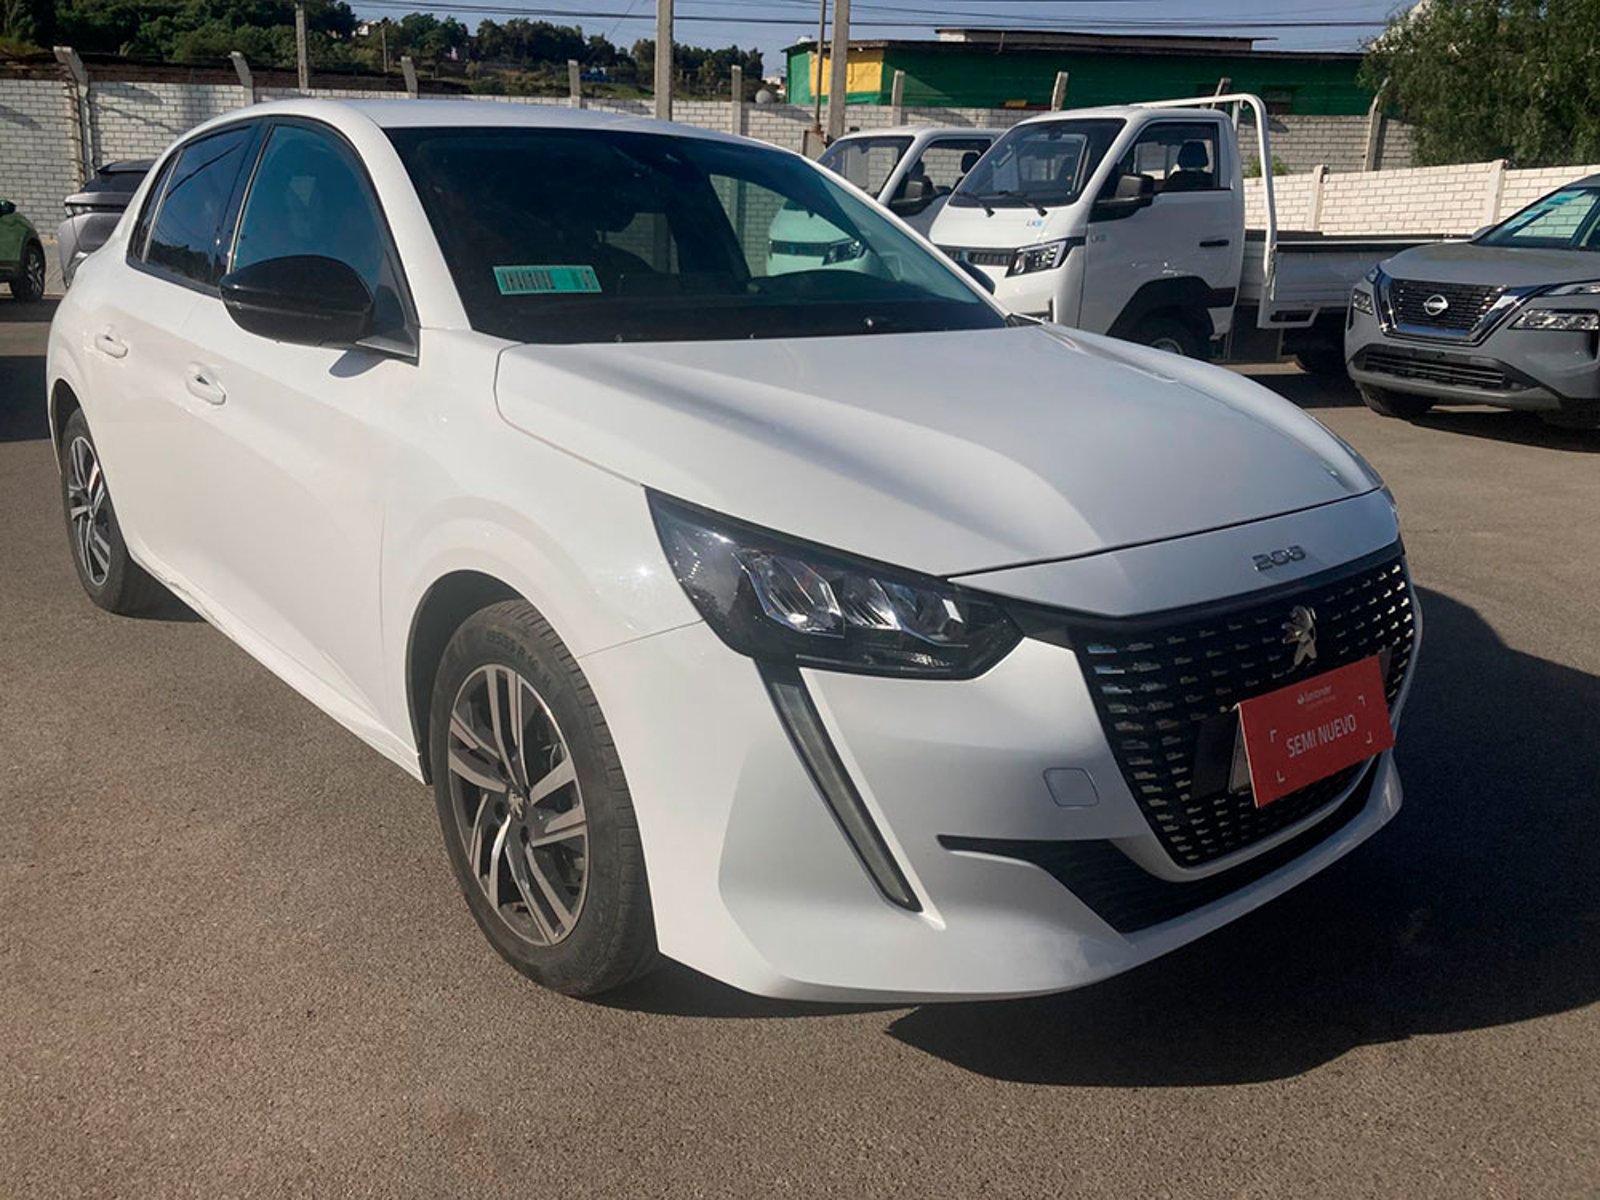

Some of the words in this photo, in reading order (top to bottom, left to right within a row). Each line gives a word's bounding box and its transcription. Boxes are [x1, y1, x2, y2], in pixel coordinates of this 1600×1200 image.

[1252, 545, 1306, 571] 208
[1286, 729, 1317, 758] SEMI
[1317, 714, 1357, 746] NUEVO
